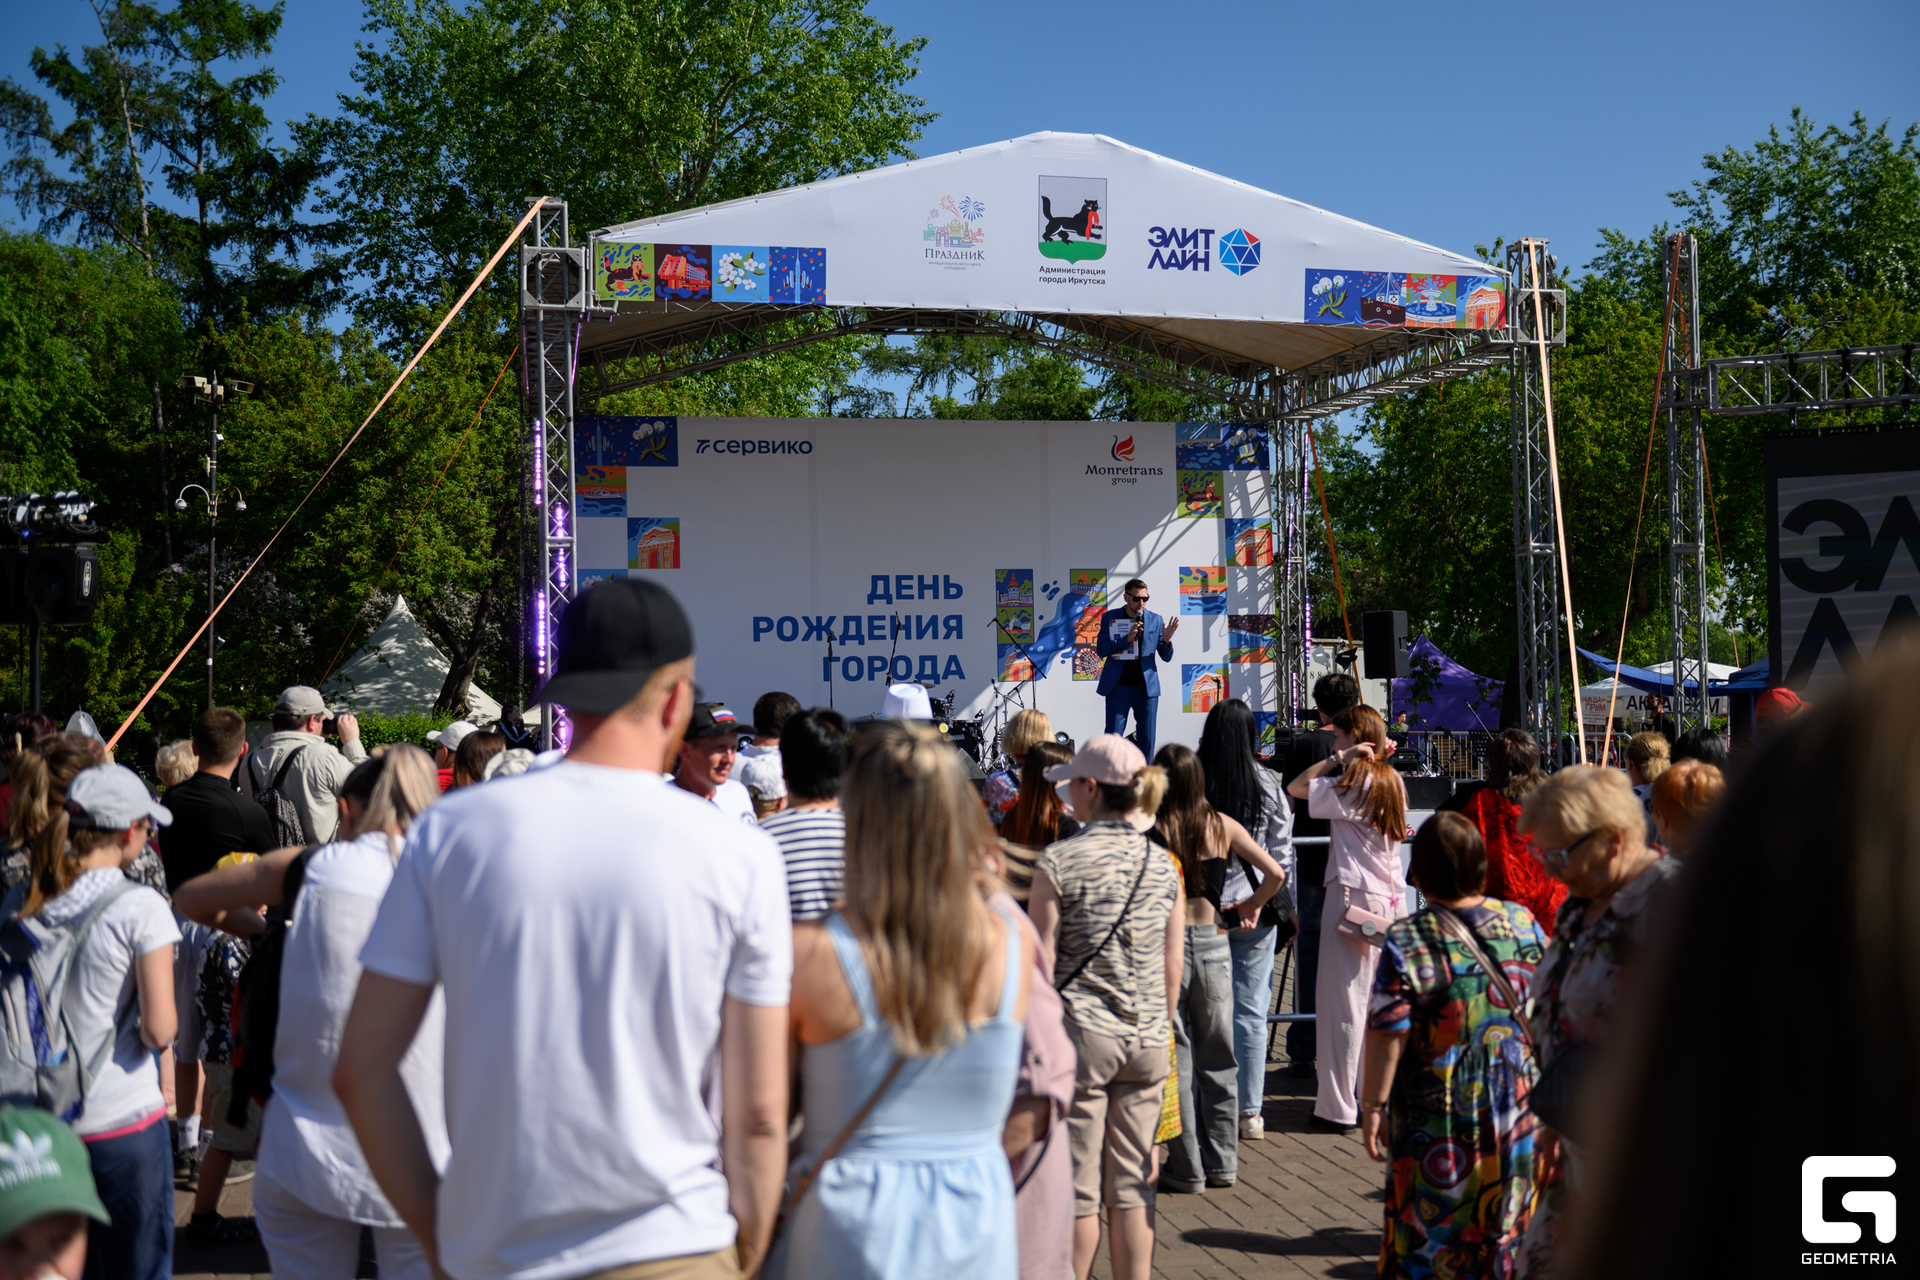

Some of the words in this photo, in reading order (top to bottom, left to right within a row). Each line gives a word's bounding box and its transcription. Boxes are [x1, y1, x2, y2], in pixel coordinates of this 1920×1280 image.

[1148, 226, 1215, 250] ЭЛИТ
[1039, 266, 1106, 275] Администрация
[1147, 249, 1210, 272] ЛАЙН
[1068, 277, 1106, 285] Иркутска
[712, 439, 813, 456] сервико
[1085, 464, 1164, 476] Monretrans
[1111, 477, 1138, 486] group
[866, 574, 964, 605] ДЕНЬ
[752, 614, 963, 646] РОЖДЕНИЯ
[822, 654, 966, 685] ГОРОДА
